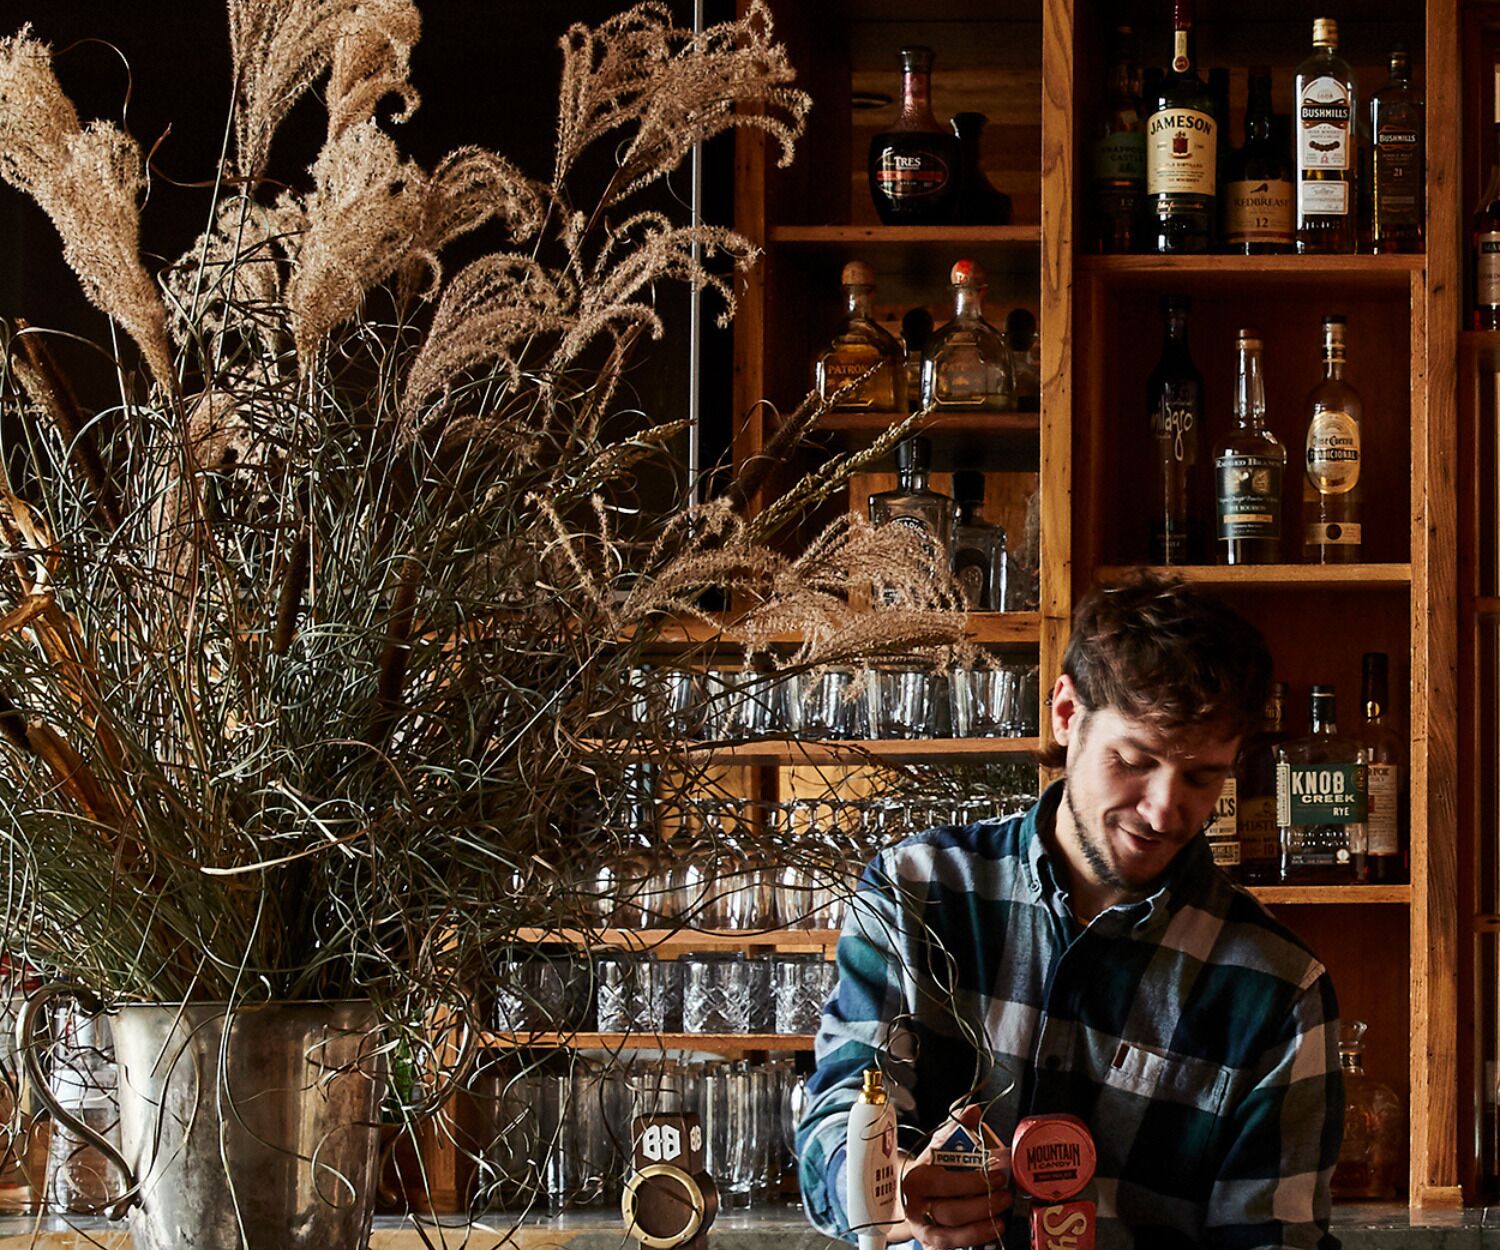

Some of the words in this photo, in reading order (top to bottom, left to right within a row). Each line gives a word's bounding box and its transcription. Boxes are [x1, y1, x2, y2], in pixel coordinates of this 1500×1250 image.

[1302, 107, 1349, 118] BUSHMILLS
[1150, 115, 1212, 135] JAMESON
[1378, 134, 1416, 142] BUSHMILLS
[894, 156, 921, 167] TRES
[1256, 217, 1268, 228] 12
[1291, 770, 1345, 795] KNOB
[1301, 794, 1356, 804] CREEK
[1332, 806, 1350, 816] RYE
[937, 1154, 961, 1163] PORT
[1027, 1143, 1081, 1171] MOUNTAIN
[1038, 1161, 1071, 1170] CANDY
